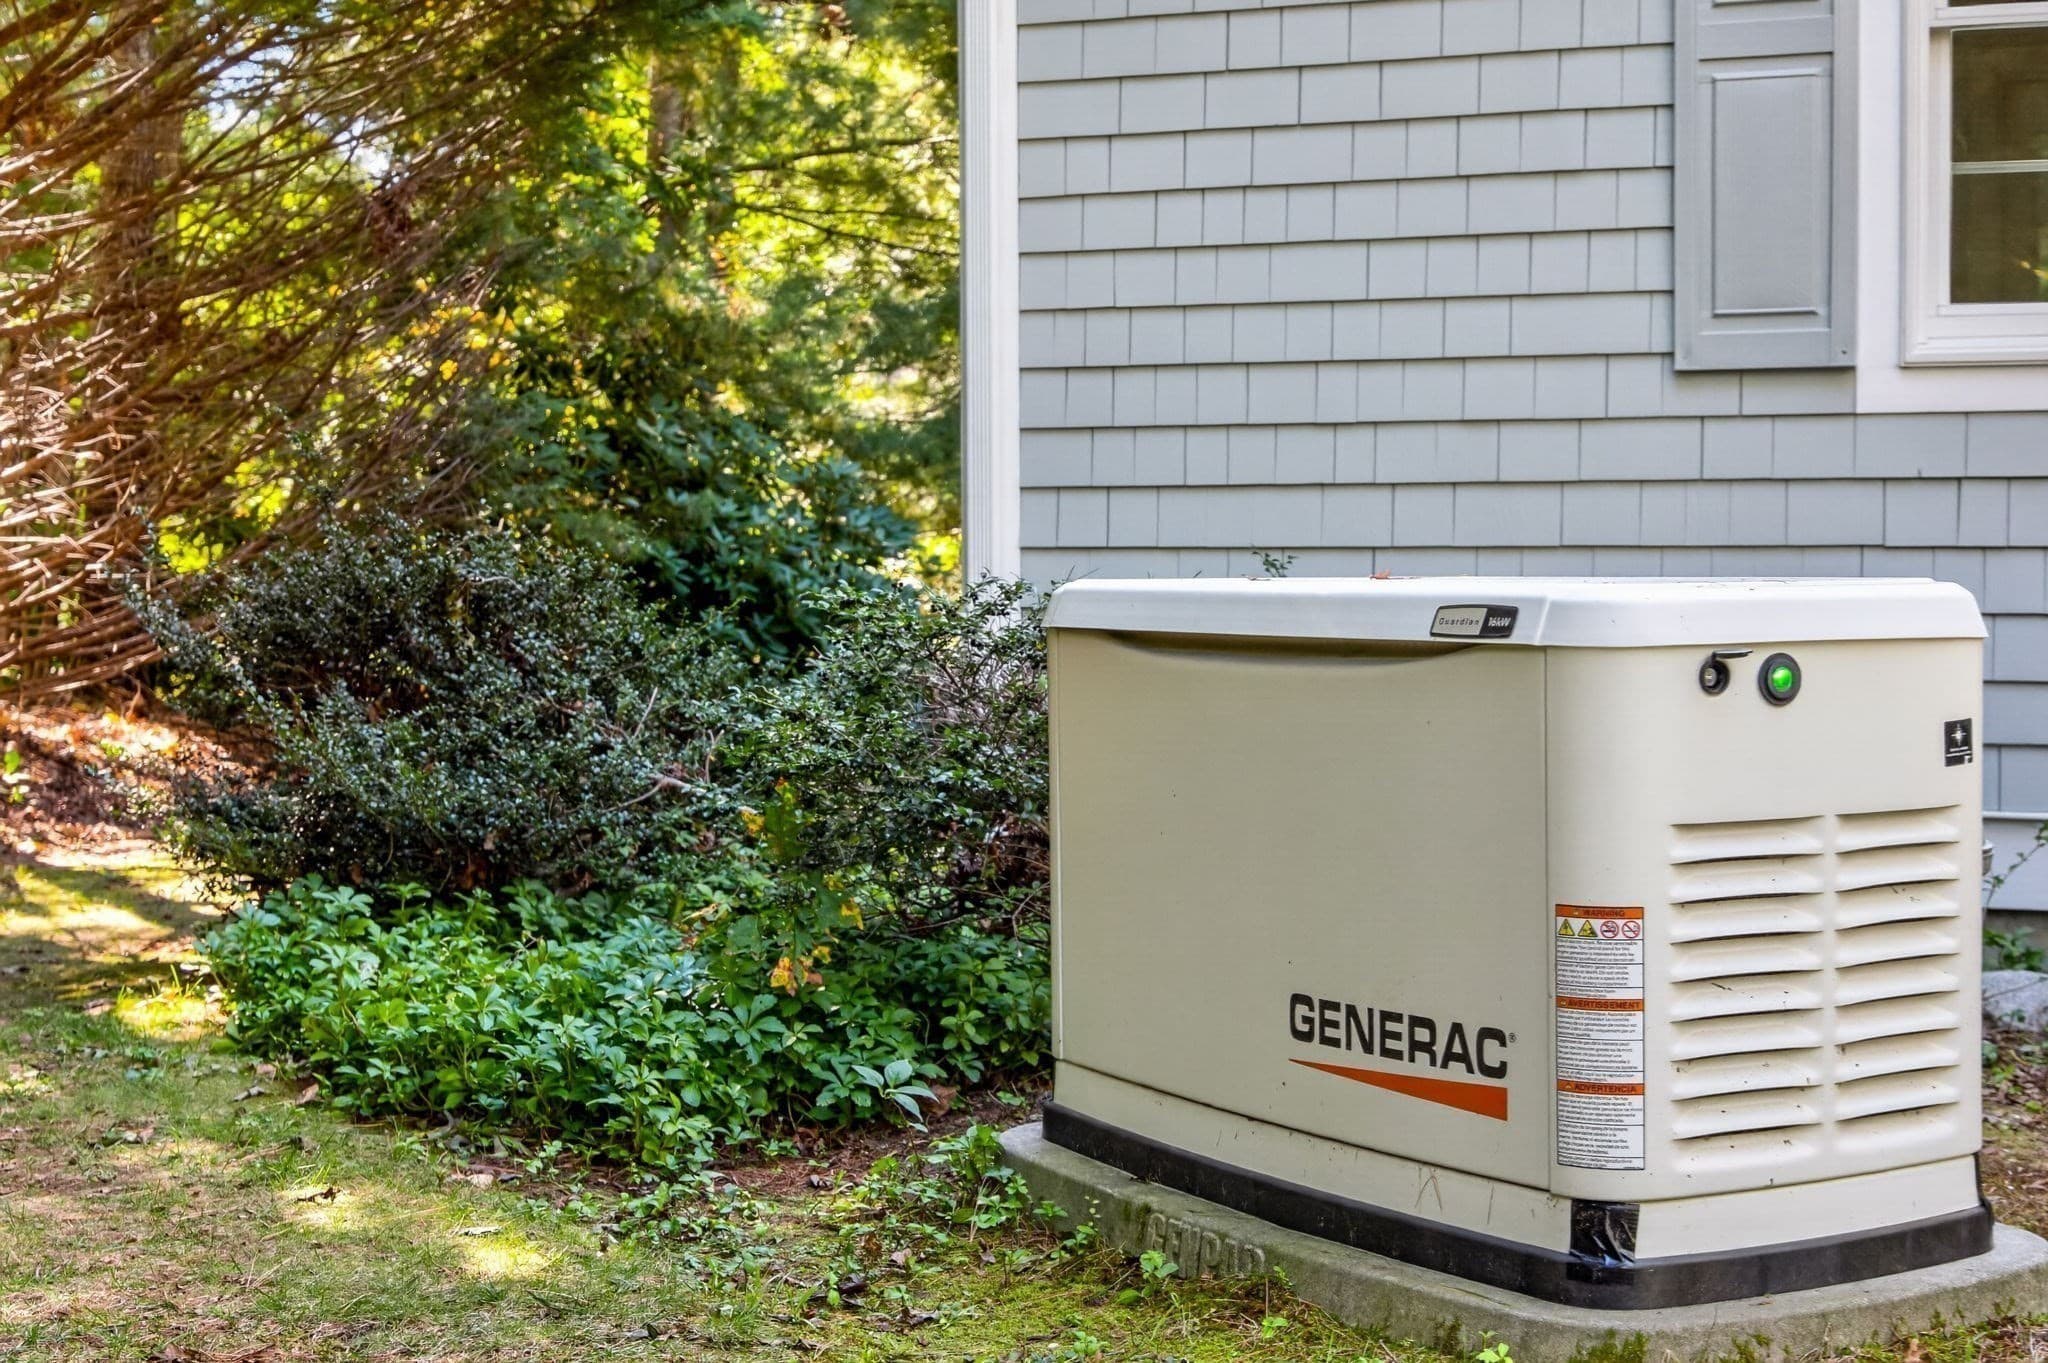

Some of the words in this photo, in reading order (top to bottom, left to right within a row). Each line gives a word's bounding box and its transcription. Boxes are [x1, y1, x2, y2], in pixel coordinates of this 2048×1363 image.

[1439, 617, 1480, 626] Guardian
[1583, 909, 1625, 917] WARNING
[1568, 999, 1641, 1010] AVERTISSEMENT
[1575, 1083, 1637, 1093] ADVERTENCIA
